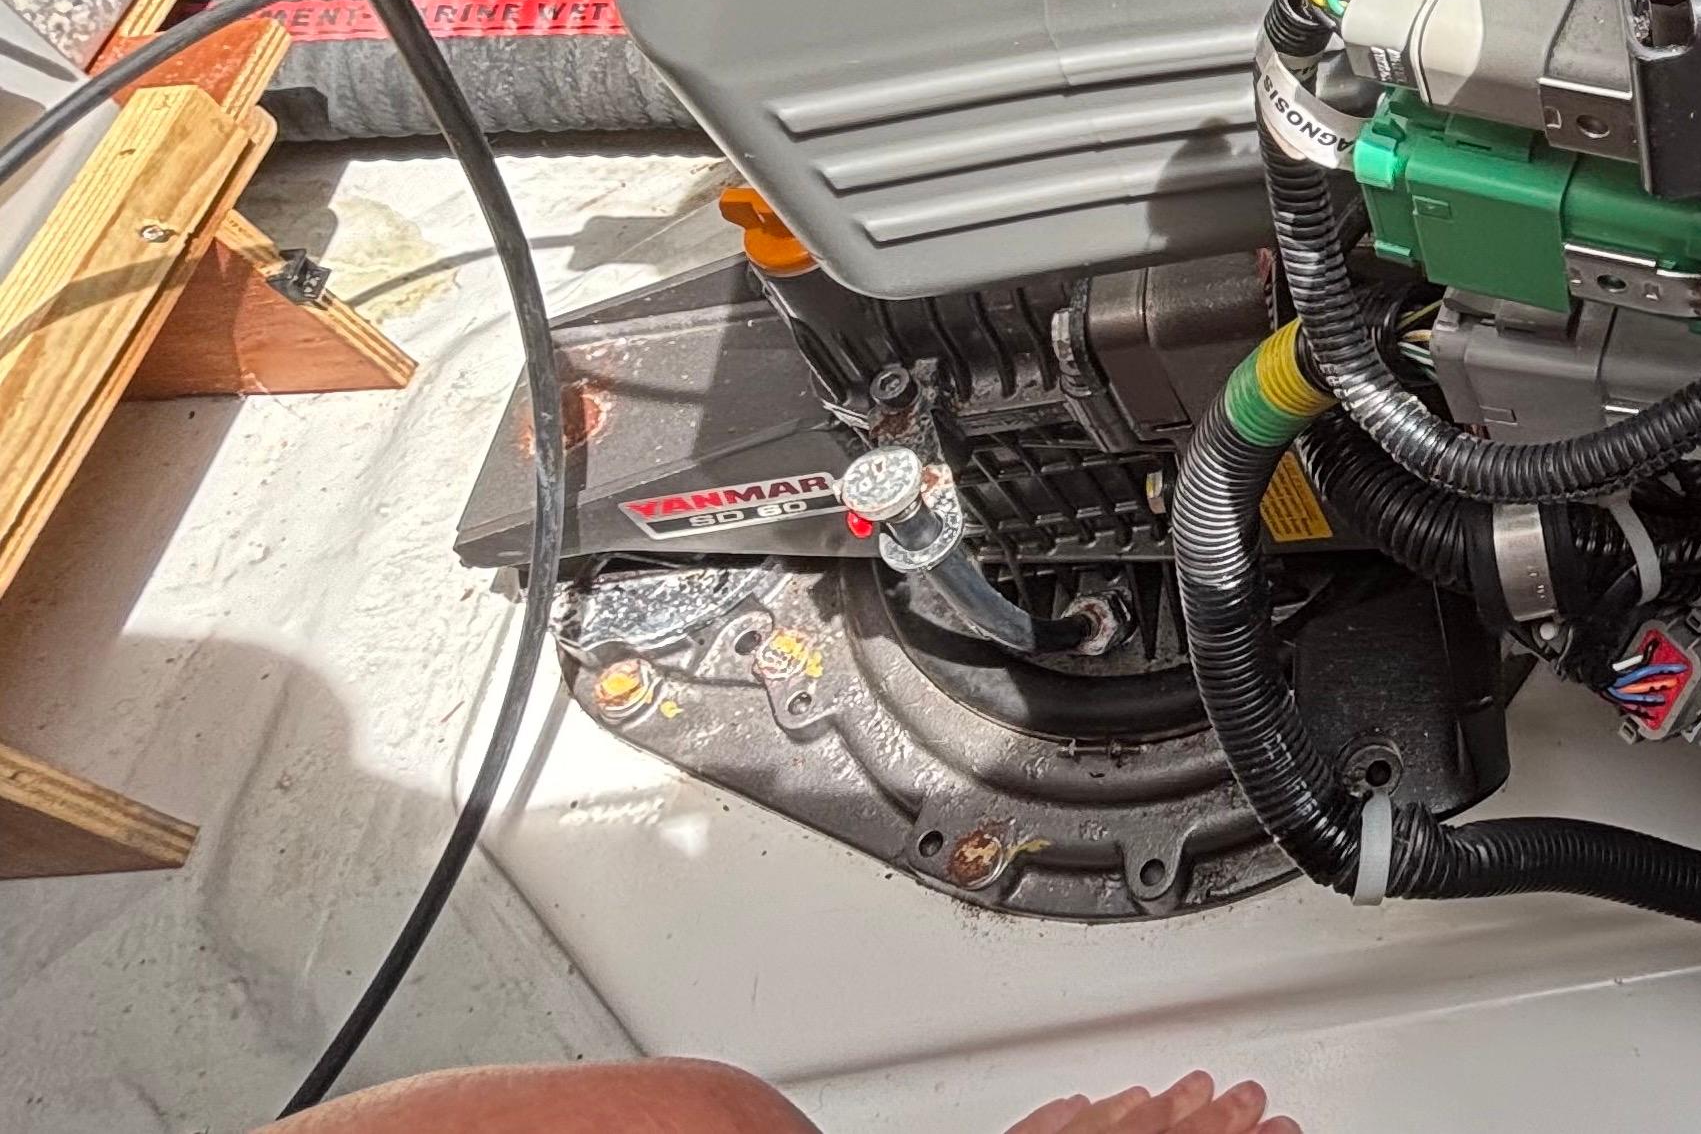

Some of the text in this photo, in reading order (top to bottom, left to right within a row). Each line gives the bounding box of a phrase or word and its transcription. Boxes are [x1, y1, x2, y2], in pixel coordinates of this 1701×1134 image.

[538, 2, 609, 21] WET
[1262, 74, 1357, 155] AGNOSIS
[626, 476, 830, 521] YANMAR
[688, 500, 807, 527] SD 60
